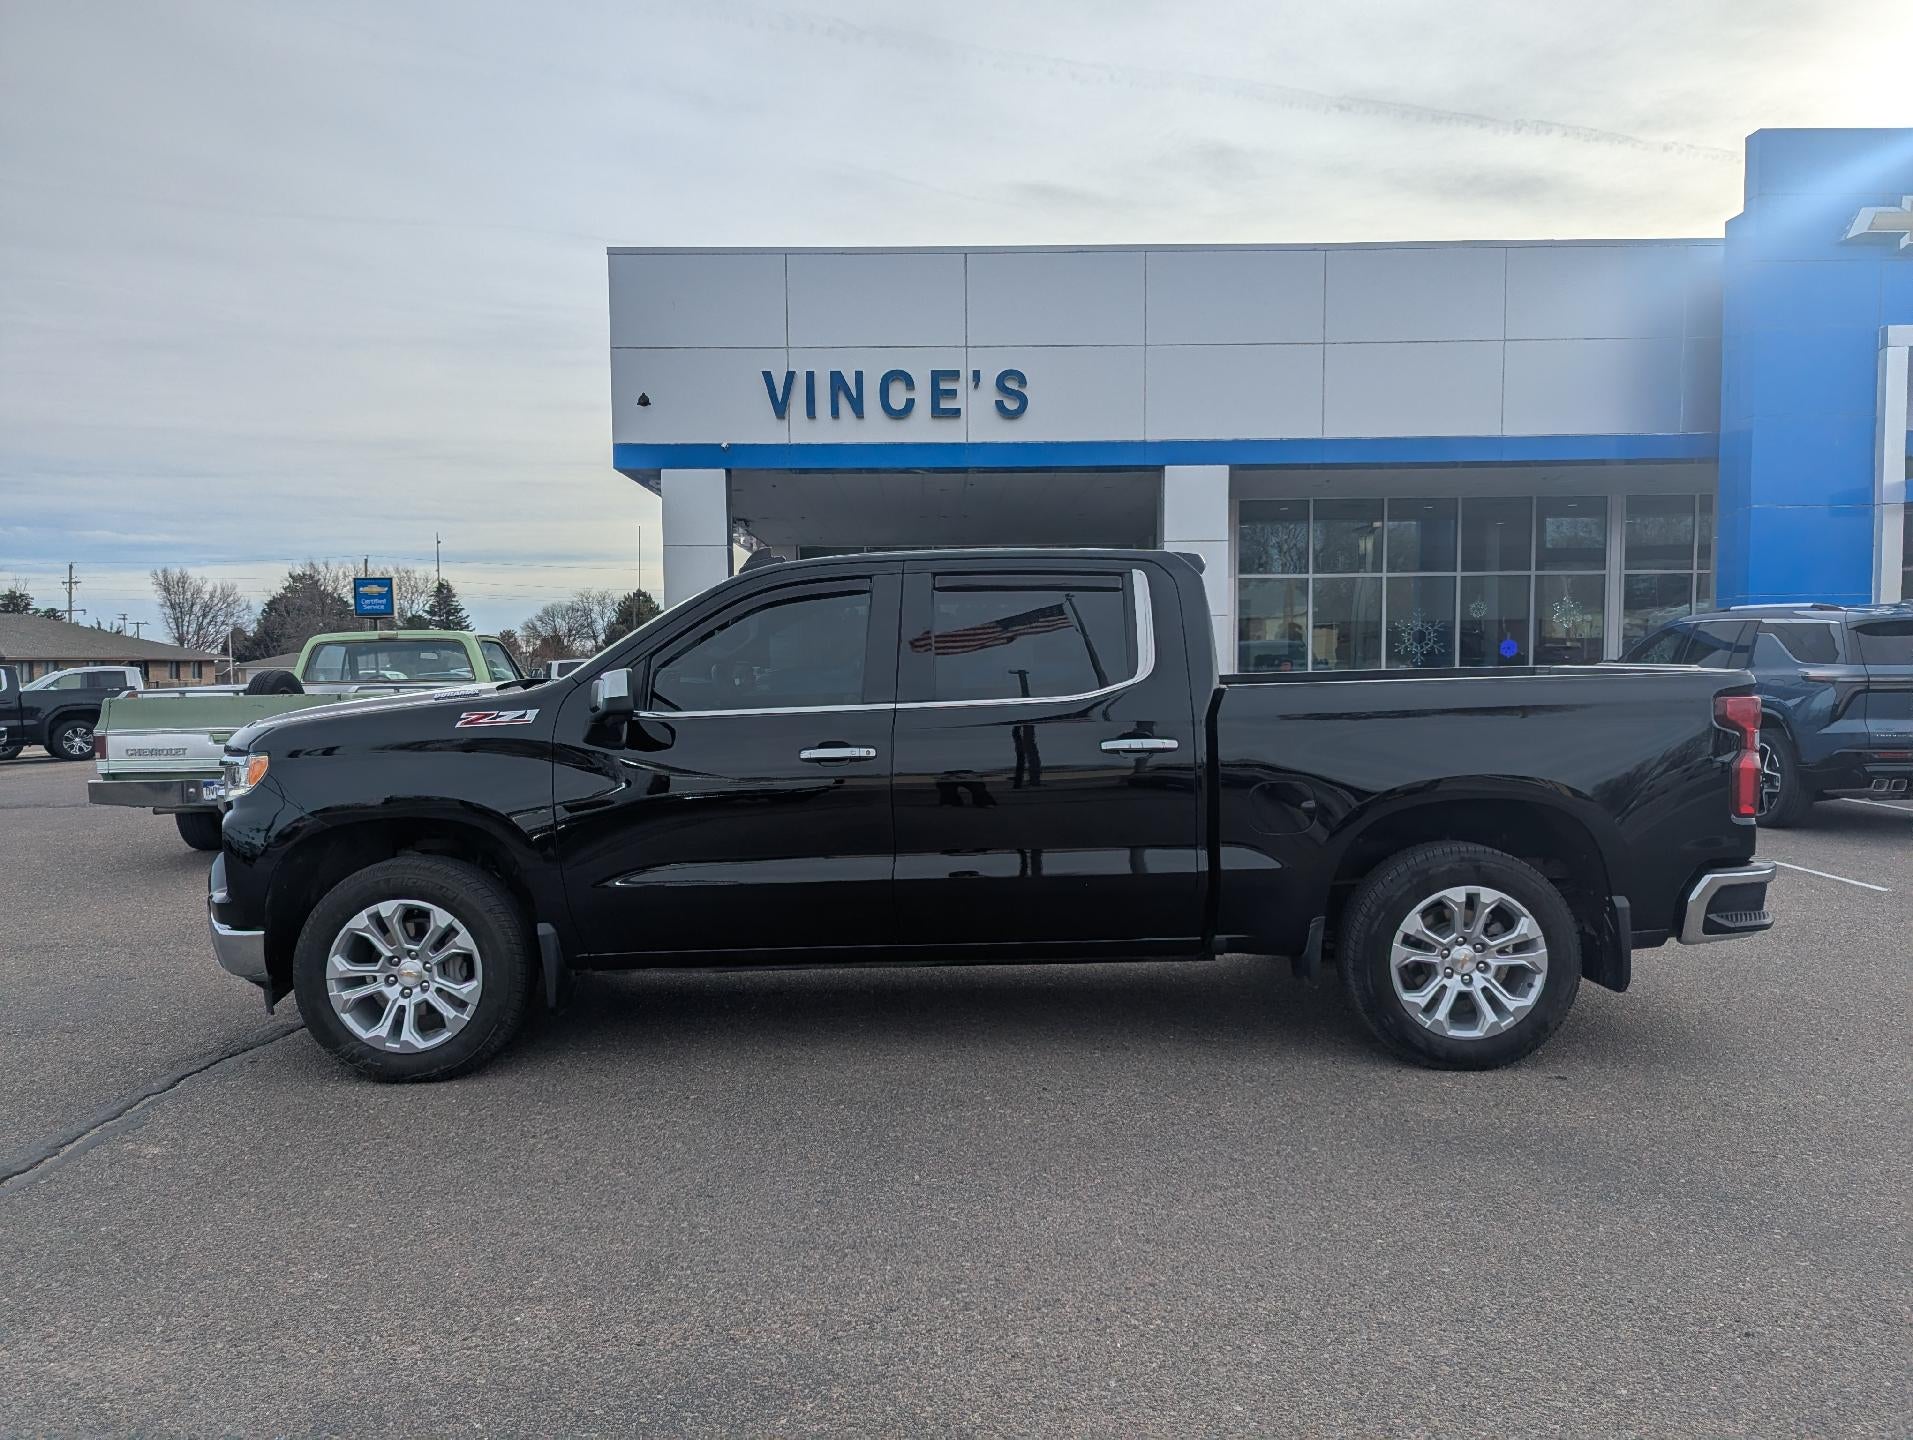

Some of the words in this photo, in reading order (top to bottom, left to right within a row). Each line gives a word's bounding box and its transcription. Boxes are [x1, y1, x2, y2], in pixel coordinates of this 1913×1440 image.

[761, 369, 1029, 419] VINCE'S
[455, 708, 540, 728] Z71
[125, 747, 188, 757] CHEVROLET
